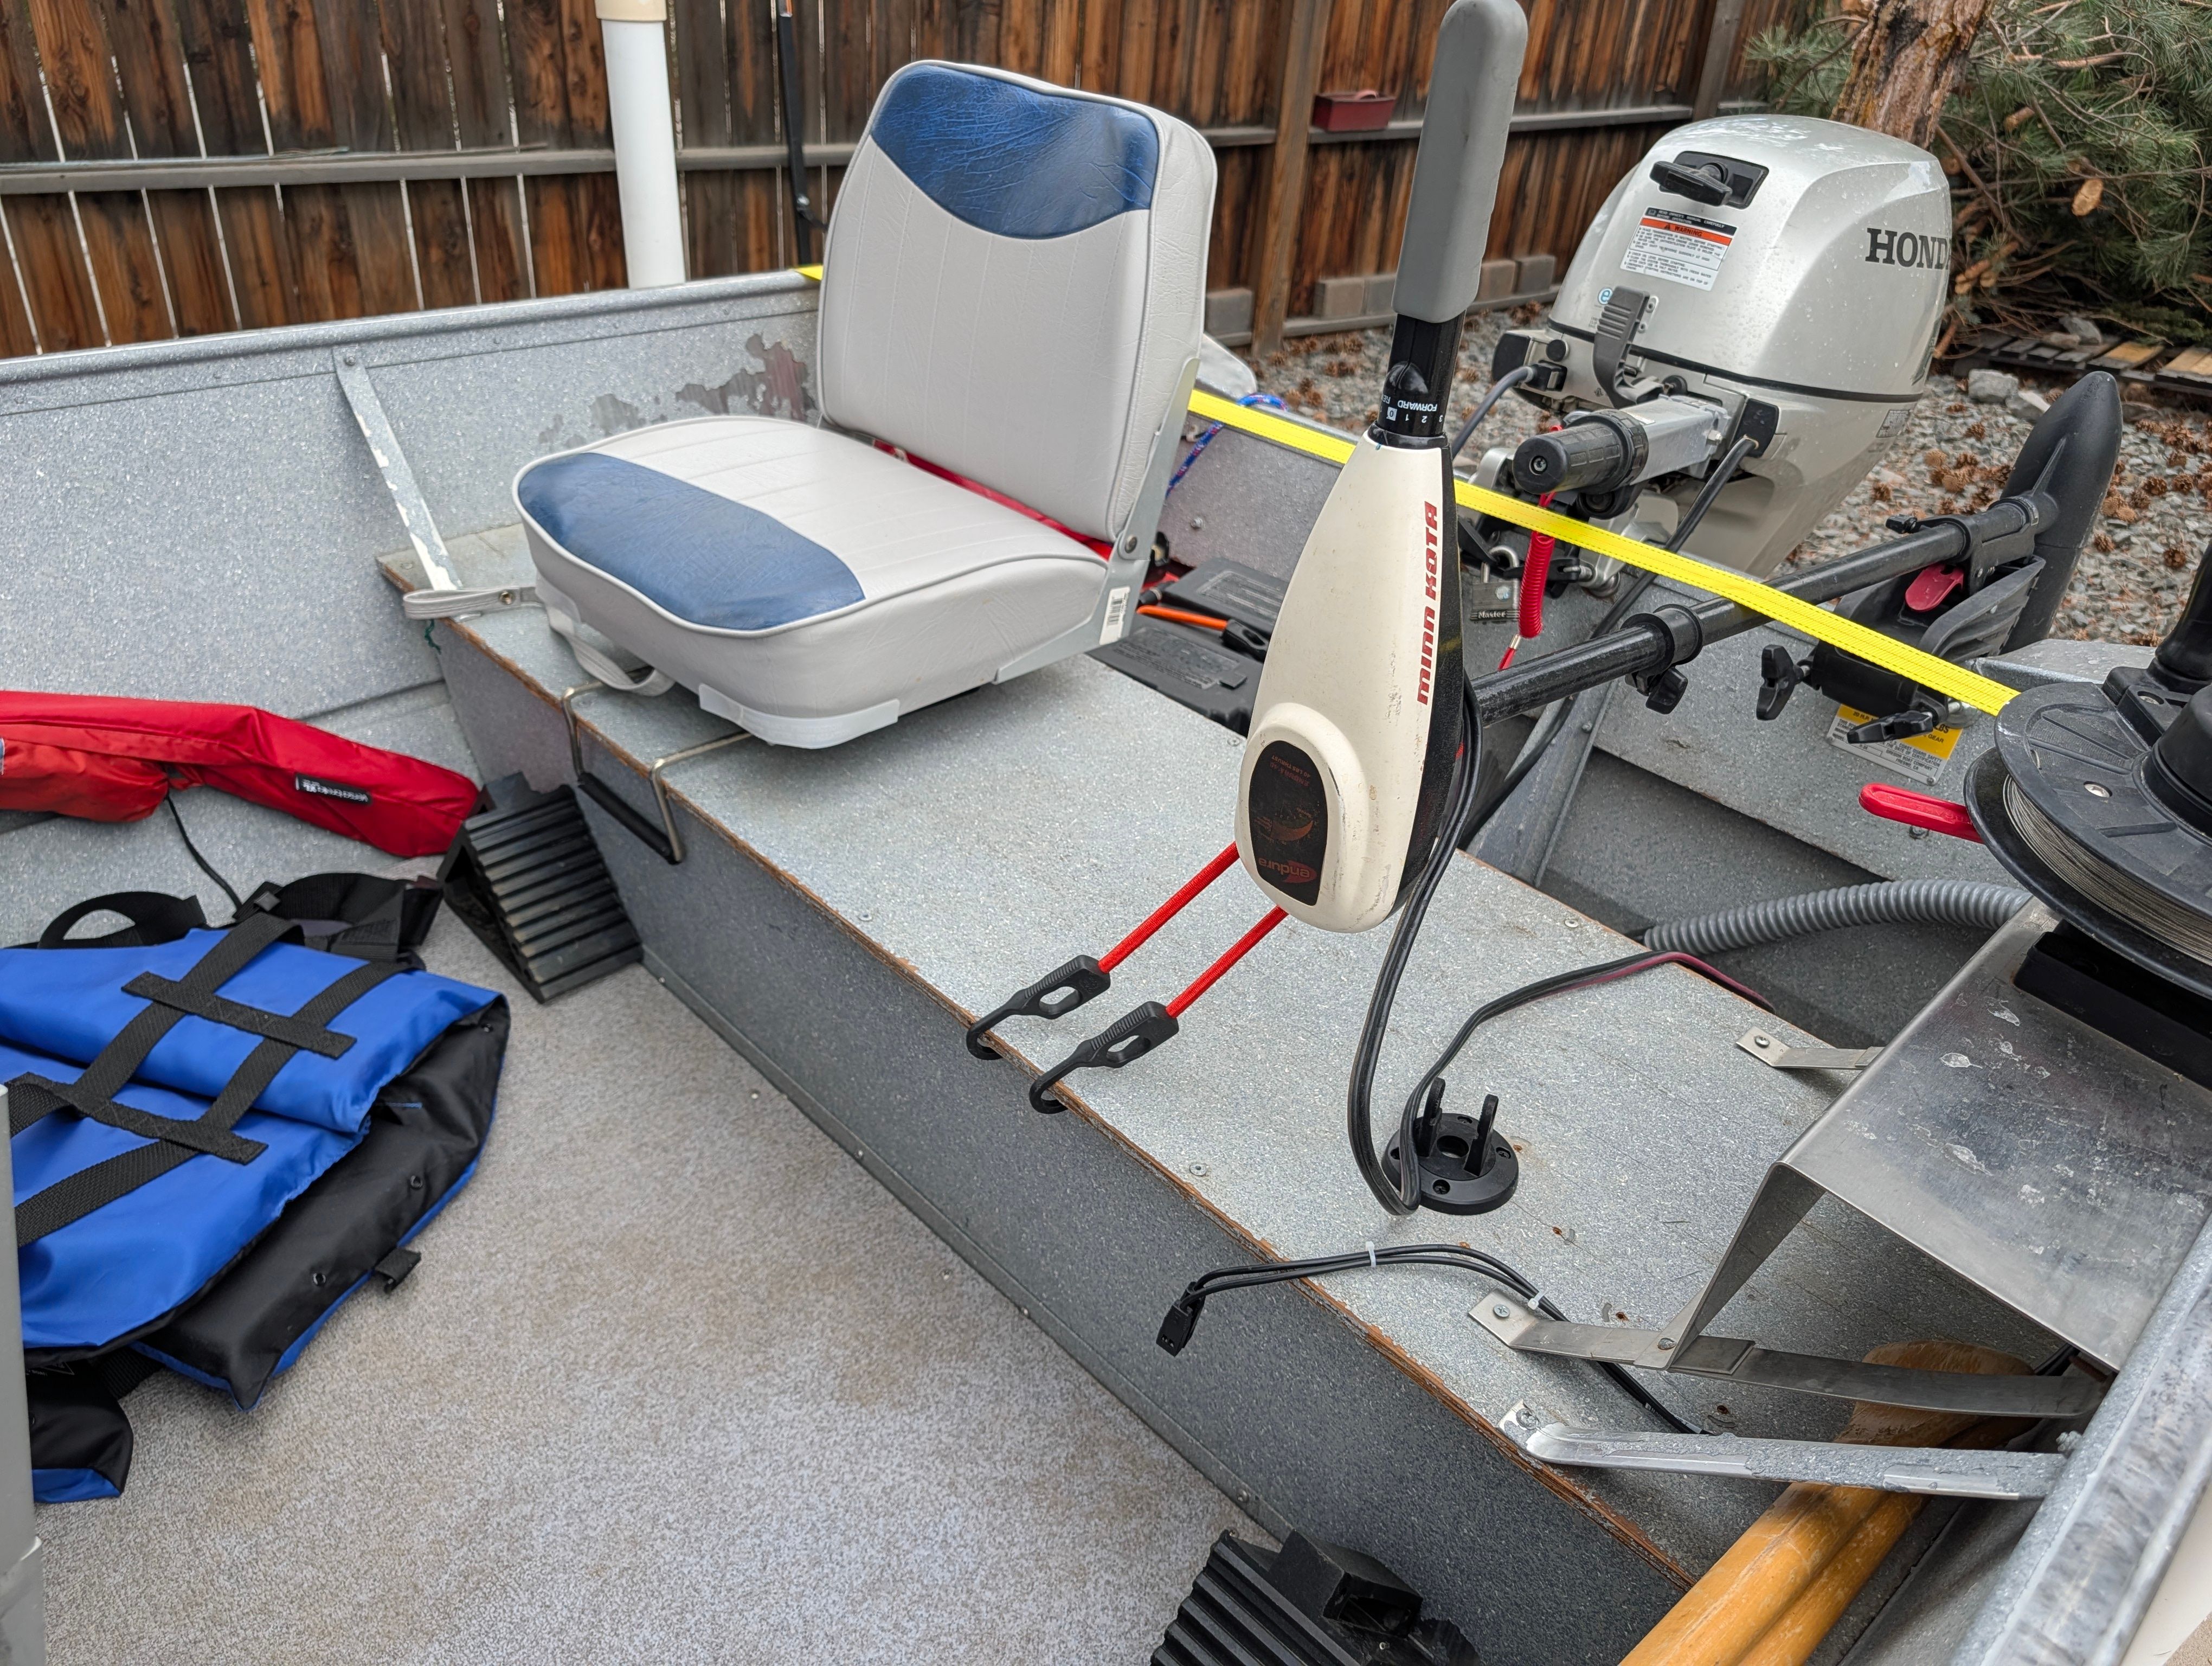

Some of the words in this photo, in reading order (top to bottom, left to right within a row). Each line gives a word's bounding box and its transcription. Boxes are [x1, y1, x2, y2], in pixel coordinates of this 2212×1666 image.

[1675, 226, 1702, 237] WARNING
[1397, 400, 1438, 412] FORWARD
[1424, 501, 1438, 601] KOTA
[1478, 611, 1506, 619] Master
[1928, 734, 1944, 744] GEAR
[1271, 754, 1291, 769] THRUST
[1258, 857, 1310, 878] endura
